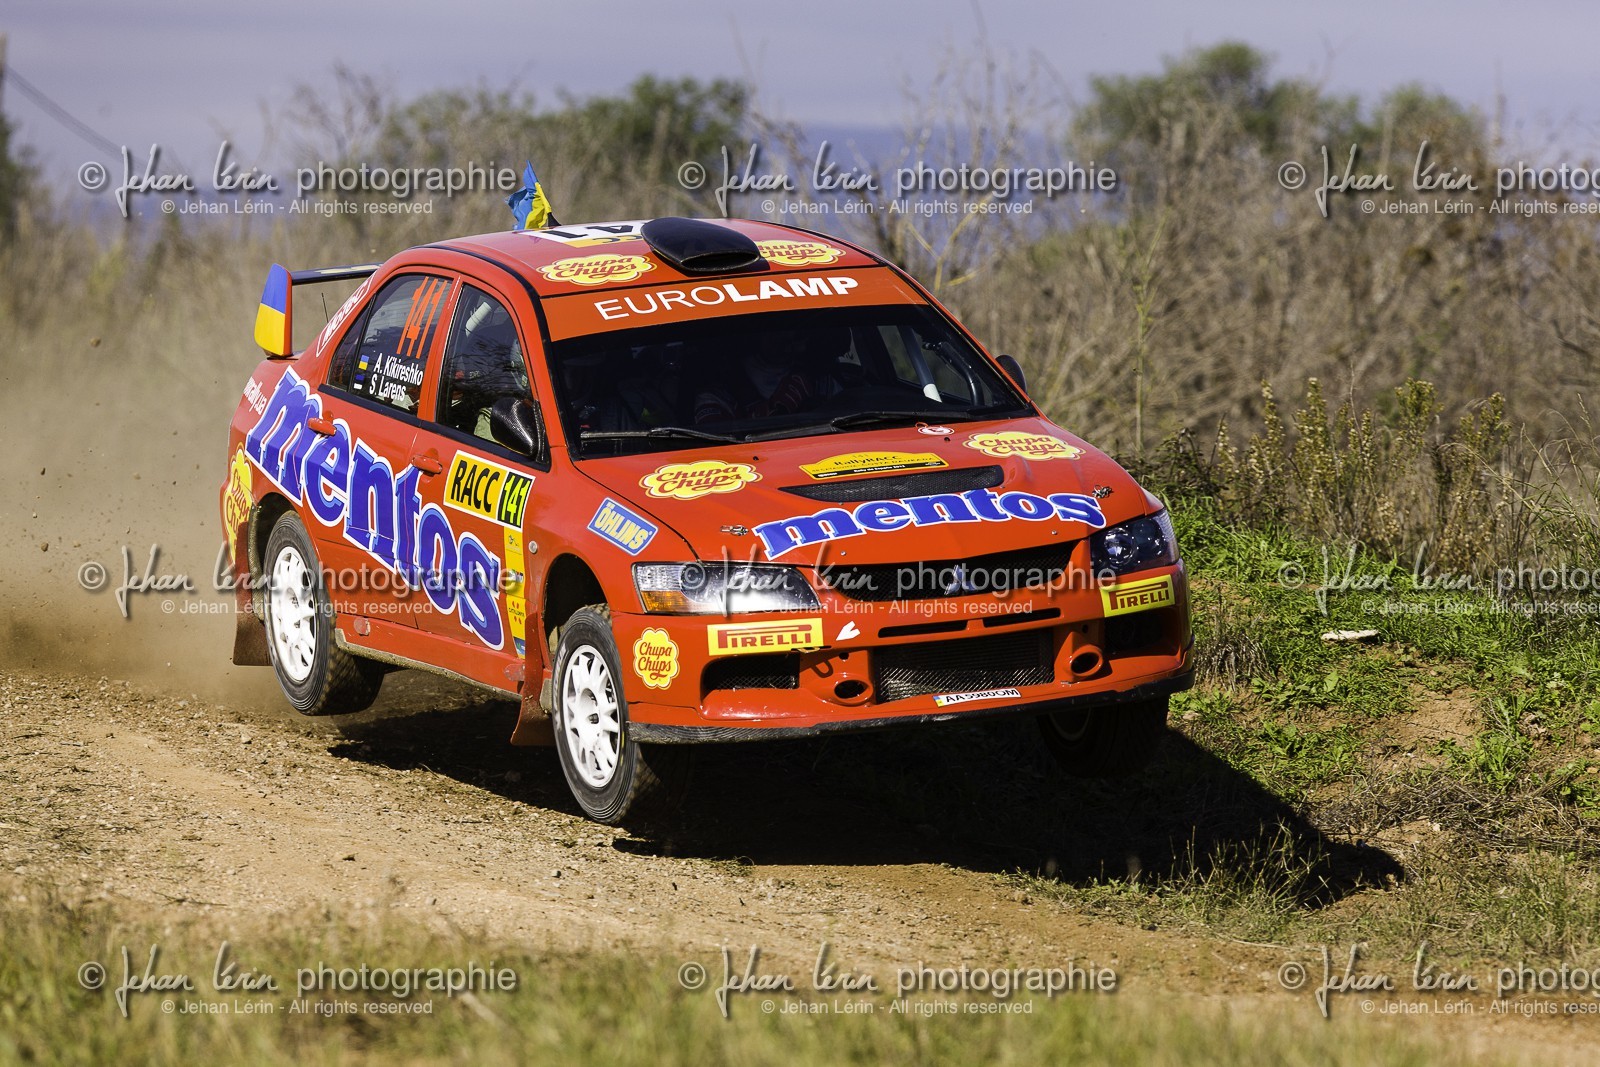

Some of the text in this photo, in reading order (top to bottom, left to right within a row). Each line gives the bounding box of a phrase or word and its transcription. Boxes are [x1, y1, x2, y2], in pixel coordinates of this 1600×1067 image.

[553, 257, 633, 271] Chupa
[555, 263, 637, 279] Chups
[594, 276, 860, 321] EUROLAMP
[396, 276, 448, 359] 141
[373, 353, 424, 386] A. Kikireshko
[369, 374, 406, 401] S. Larens
[978, 437, 1052, 449] Chupa
[991, 443, 1067, 455] Chups
[656, 466, 739, 483] Chupa
[659, 473, 743, 492] Chups
[450, 459, 531, 526] RACC 141
[244, 364, 504, 650] mentos
[594, 503, 650, 550] ÖHLINS
[752, 487, 1107, 561] mentos
[1111, 581, 1170, 610] PIRELLI
[718, 624, 812, 648] PIRELLI
[639, 642, 672, 660] Chupa
[638, 657, 672, 680] Chups
